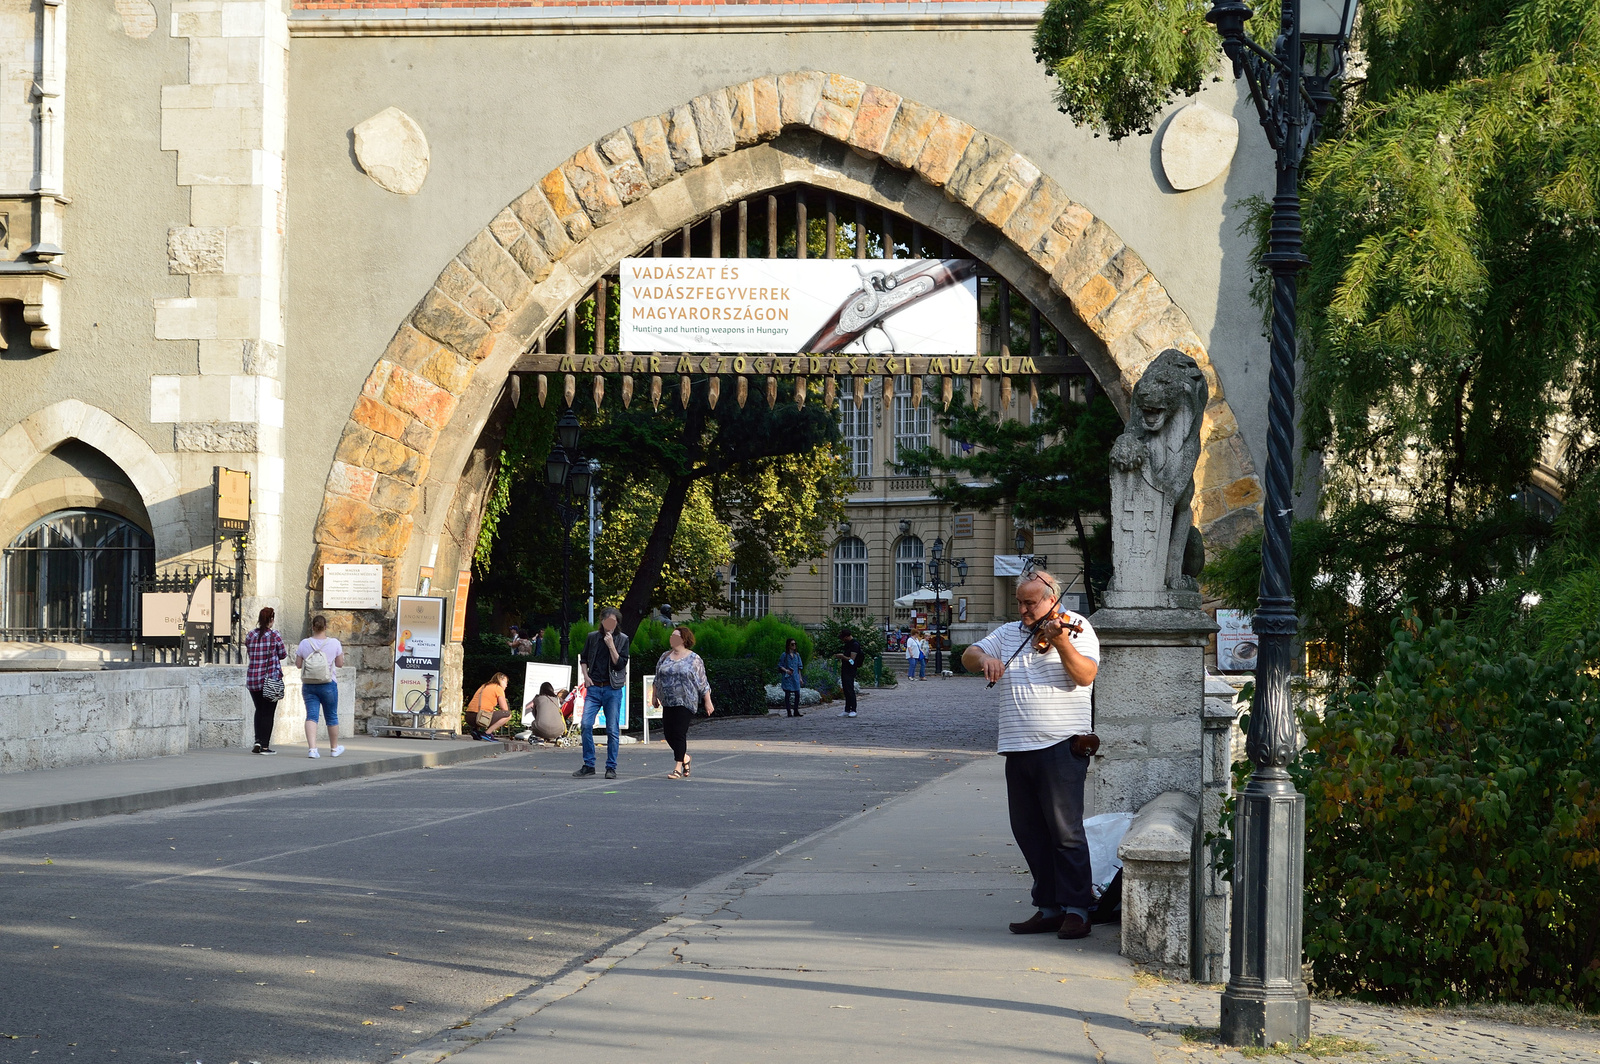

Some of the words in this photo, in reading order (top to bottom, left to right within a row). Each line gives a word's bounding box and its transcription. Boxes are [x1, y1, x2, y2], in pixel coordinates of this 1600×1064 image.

[632, 264, 716, 280] VADÁSZAT
[720, 265, 739, 280] ÉS
[632, 284, 790, 300] VADÁSZFEGYVEREK
[632, 305, 789, 321] MAGYARORSZÁGON
[632, 325, 663, 335] Hunting
[664, 326, 678, 334] and
[680, 326, 710, 335] hunting
[711, 327, 745, 335] weapons
[747, 326, 754, 334] in
[756, 326, 789, 336] Hungary
[559, 355, 661, 373] MAGYAR
